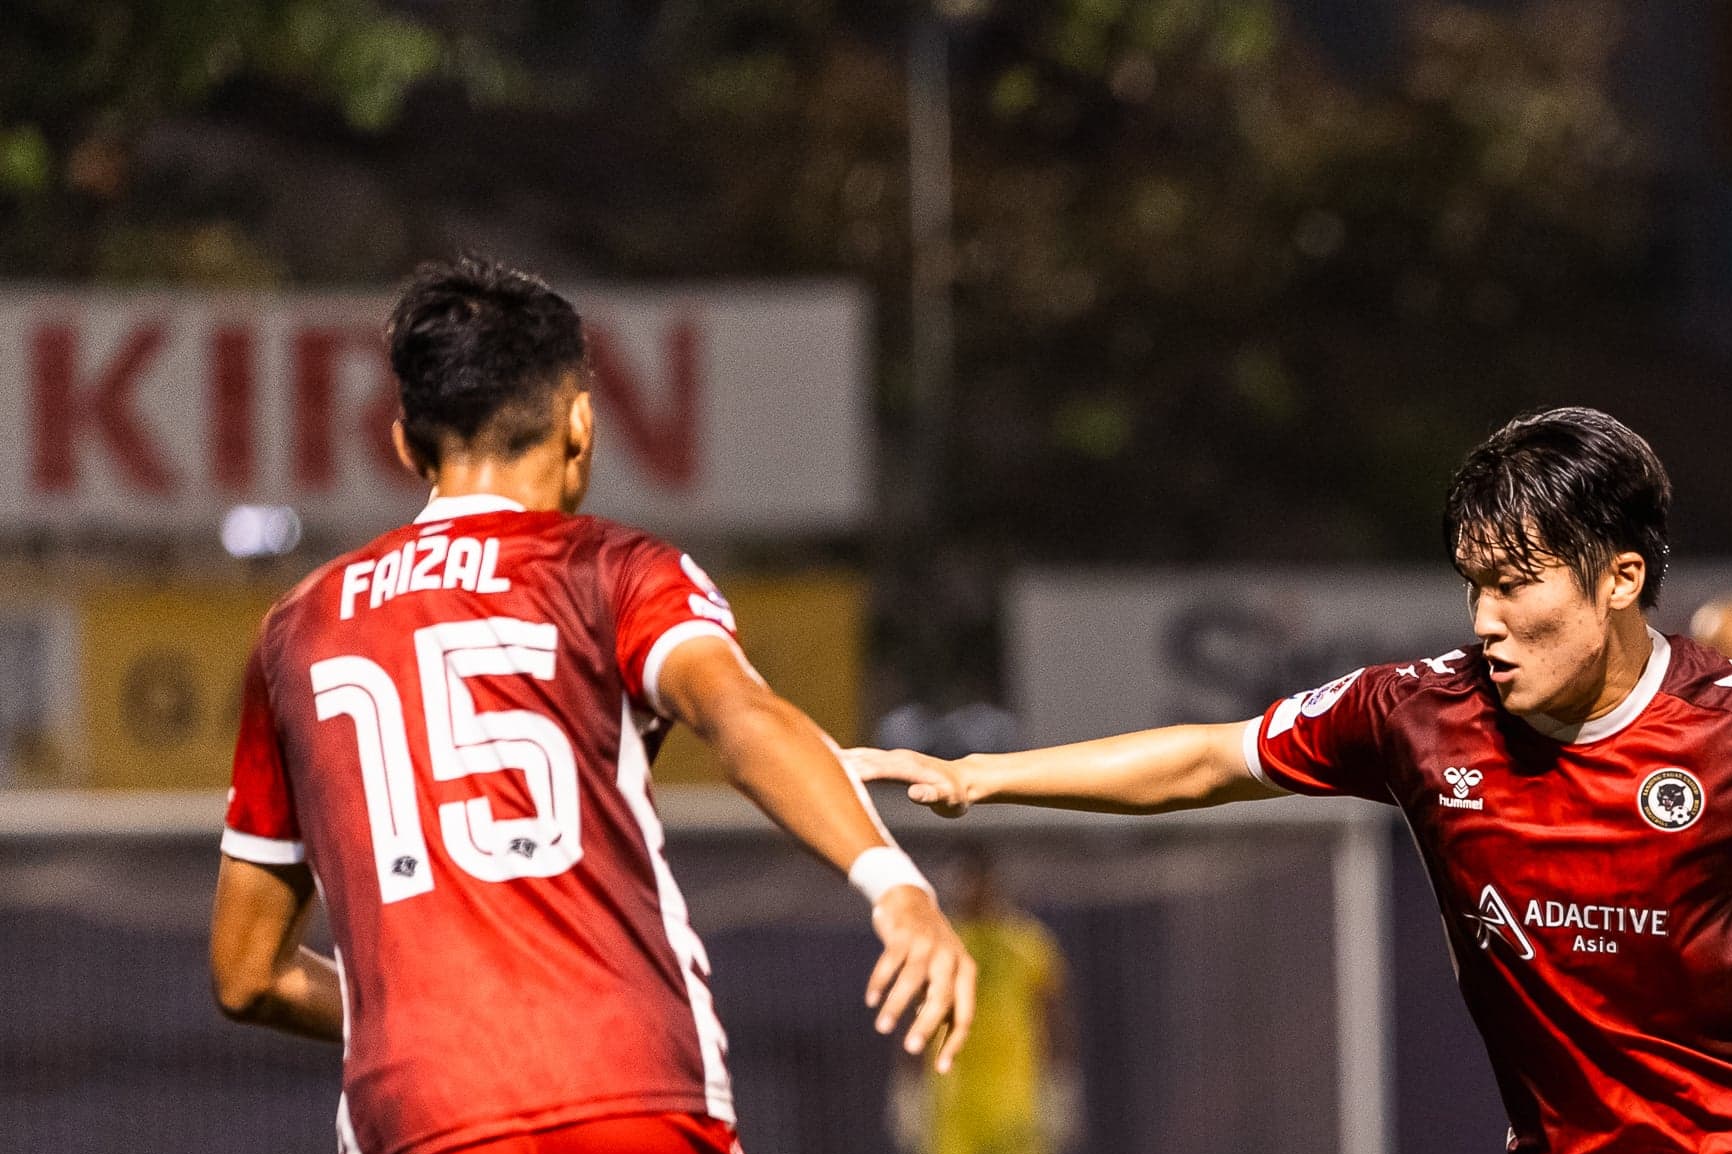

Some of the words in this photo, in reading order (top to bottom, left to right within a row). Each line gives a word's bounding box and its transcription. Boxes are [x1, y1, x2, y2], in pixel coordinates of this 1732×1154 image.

[27, 319, 704, 494] KIRN
[340, 534, 511, 621] FAIZAL
[310, 616, 584, 904] 15
[1439, 794, 1483, 810] hummel
[1525, 899, 1669, 936] ADACTIVE
[1572, 935, 1618, 954] Asia
